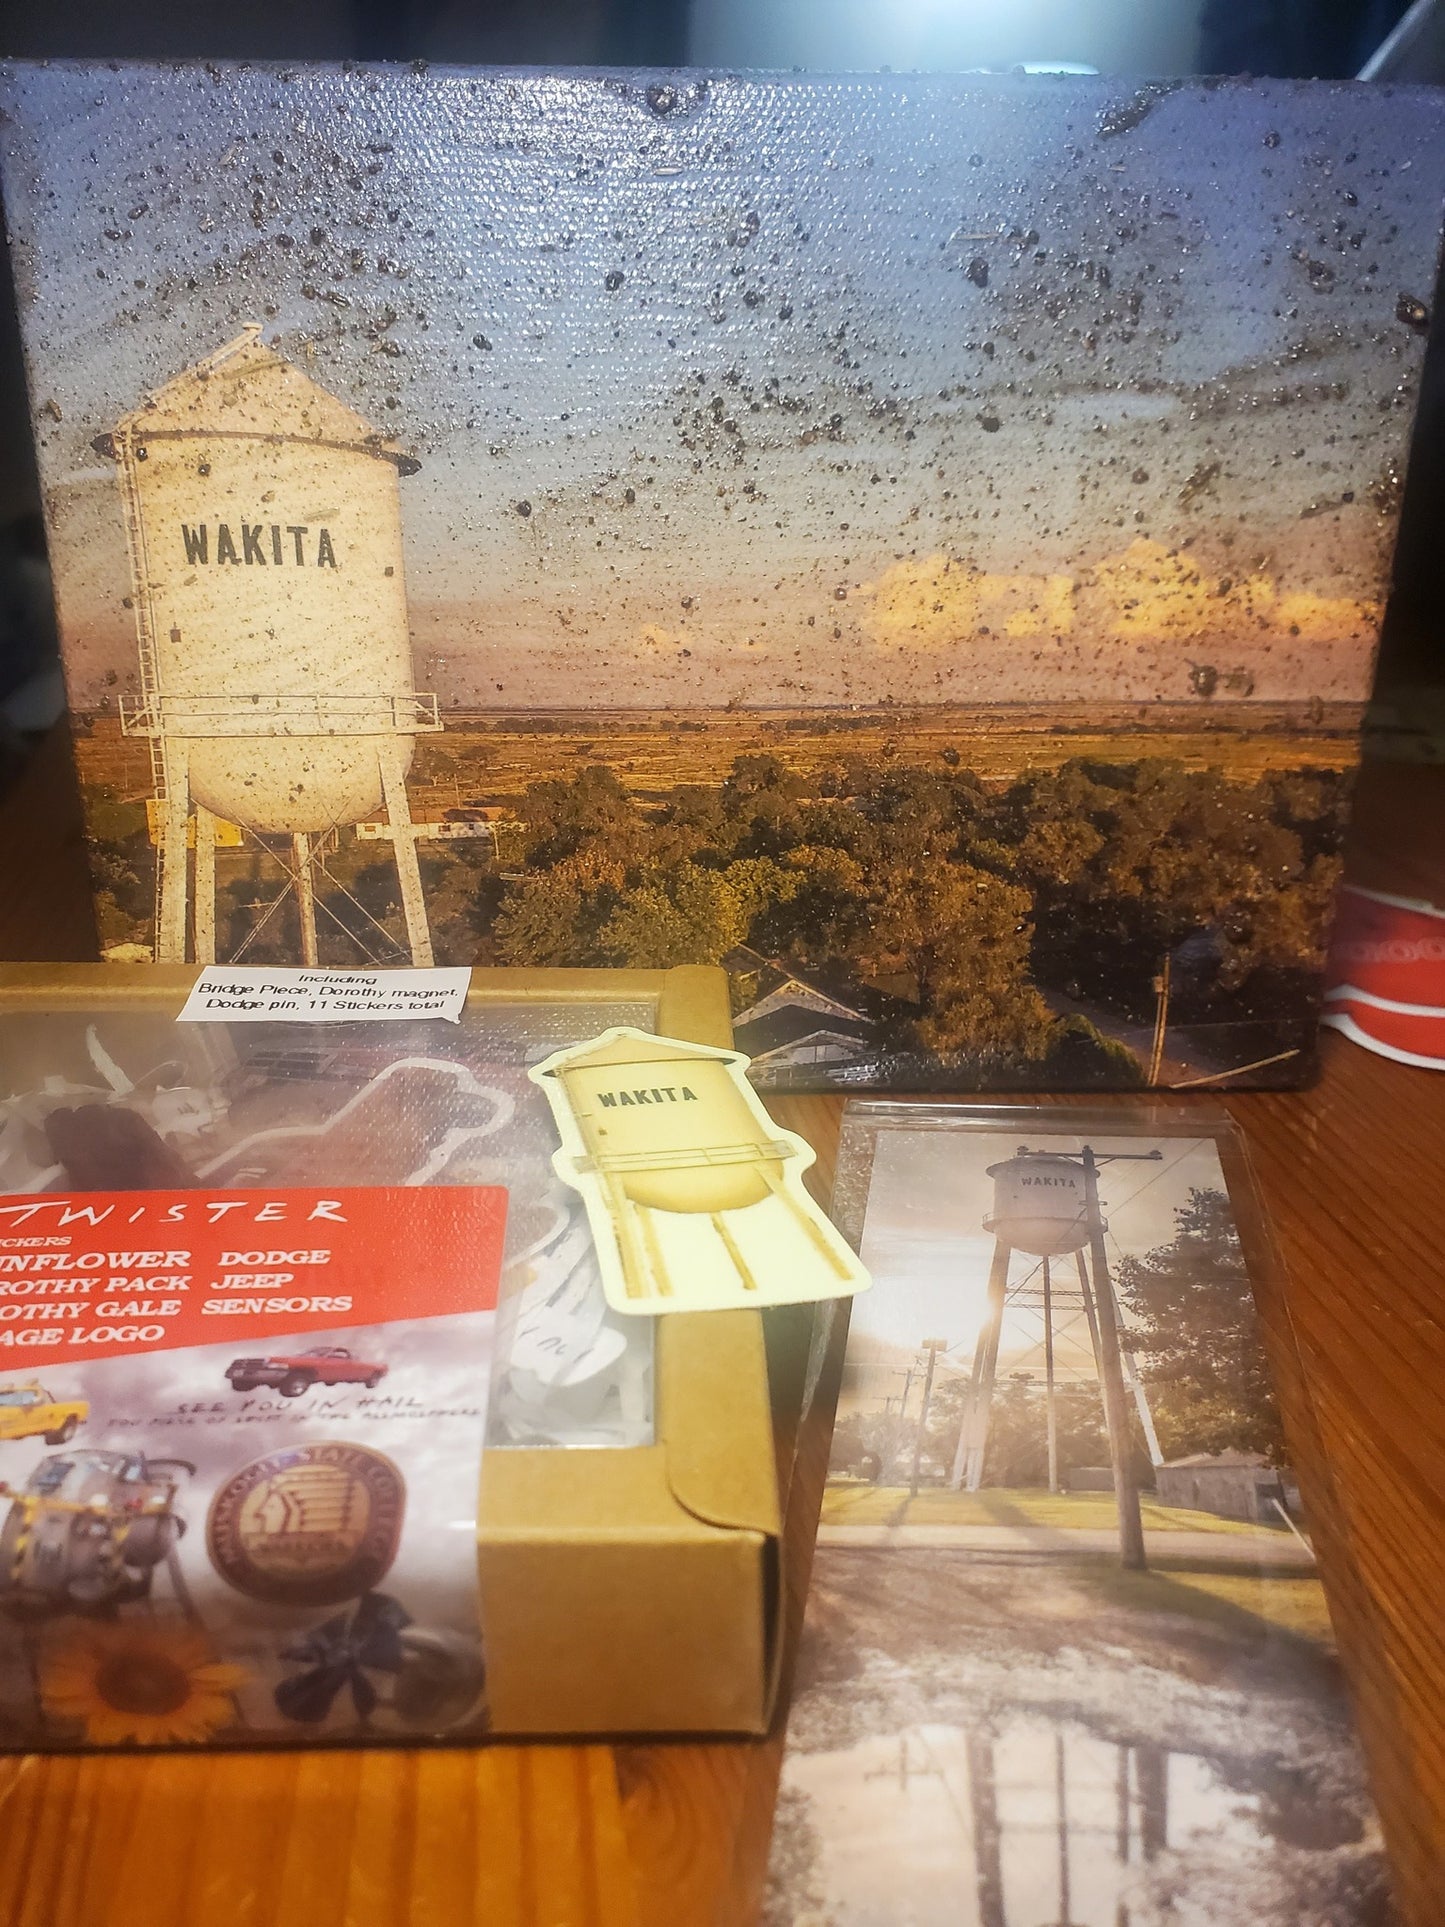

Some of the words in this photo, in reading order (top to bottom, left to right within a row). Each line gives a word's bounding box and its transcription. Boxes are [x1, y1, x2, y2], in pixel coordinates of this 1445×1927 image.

[181, 524, 337, 568] WAKITA
[298, 974, 377, 985] Including
[198, 983, 254, 995] Bridge
[319, 987, 386, 999] Dorothy
[206, 999, 264, 1010] Dodge
[268, 1000, 300, 1011] pin,
[310, 1000, 328, 1009] 11
[333, 1000, 404, 1011] Stickers
[408, 1001, 445, 1010] total
[597, 1087, 699, 1107] WAKITA
[1021, 1177, 1077, 1189] WAKITA
[0, 1200, 349, 1228] TWISTER
[0, 1236, 73, 1248] CKERS
[0, 1250, 192, 1272] NFLOWER
[218, 1250, 332, 1267] DODGE
[104, 1275, 194, 1292] PACK
[210, 1273, 295, 1290] JEEP
[95, 1300, 183, 1318] GALE
[201, 1296, 353, 1315] SENSORS
[68, 1325, 166, 1345] LOGO
[241, 1399, 293, 1412] YOU
